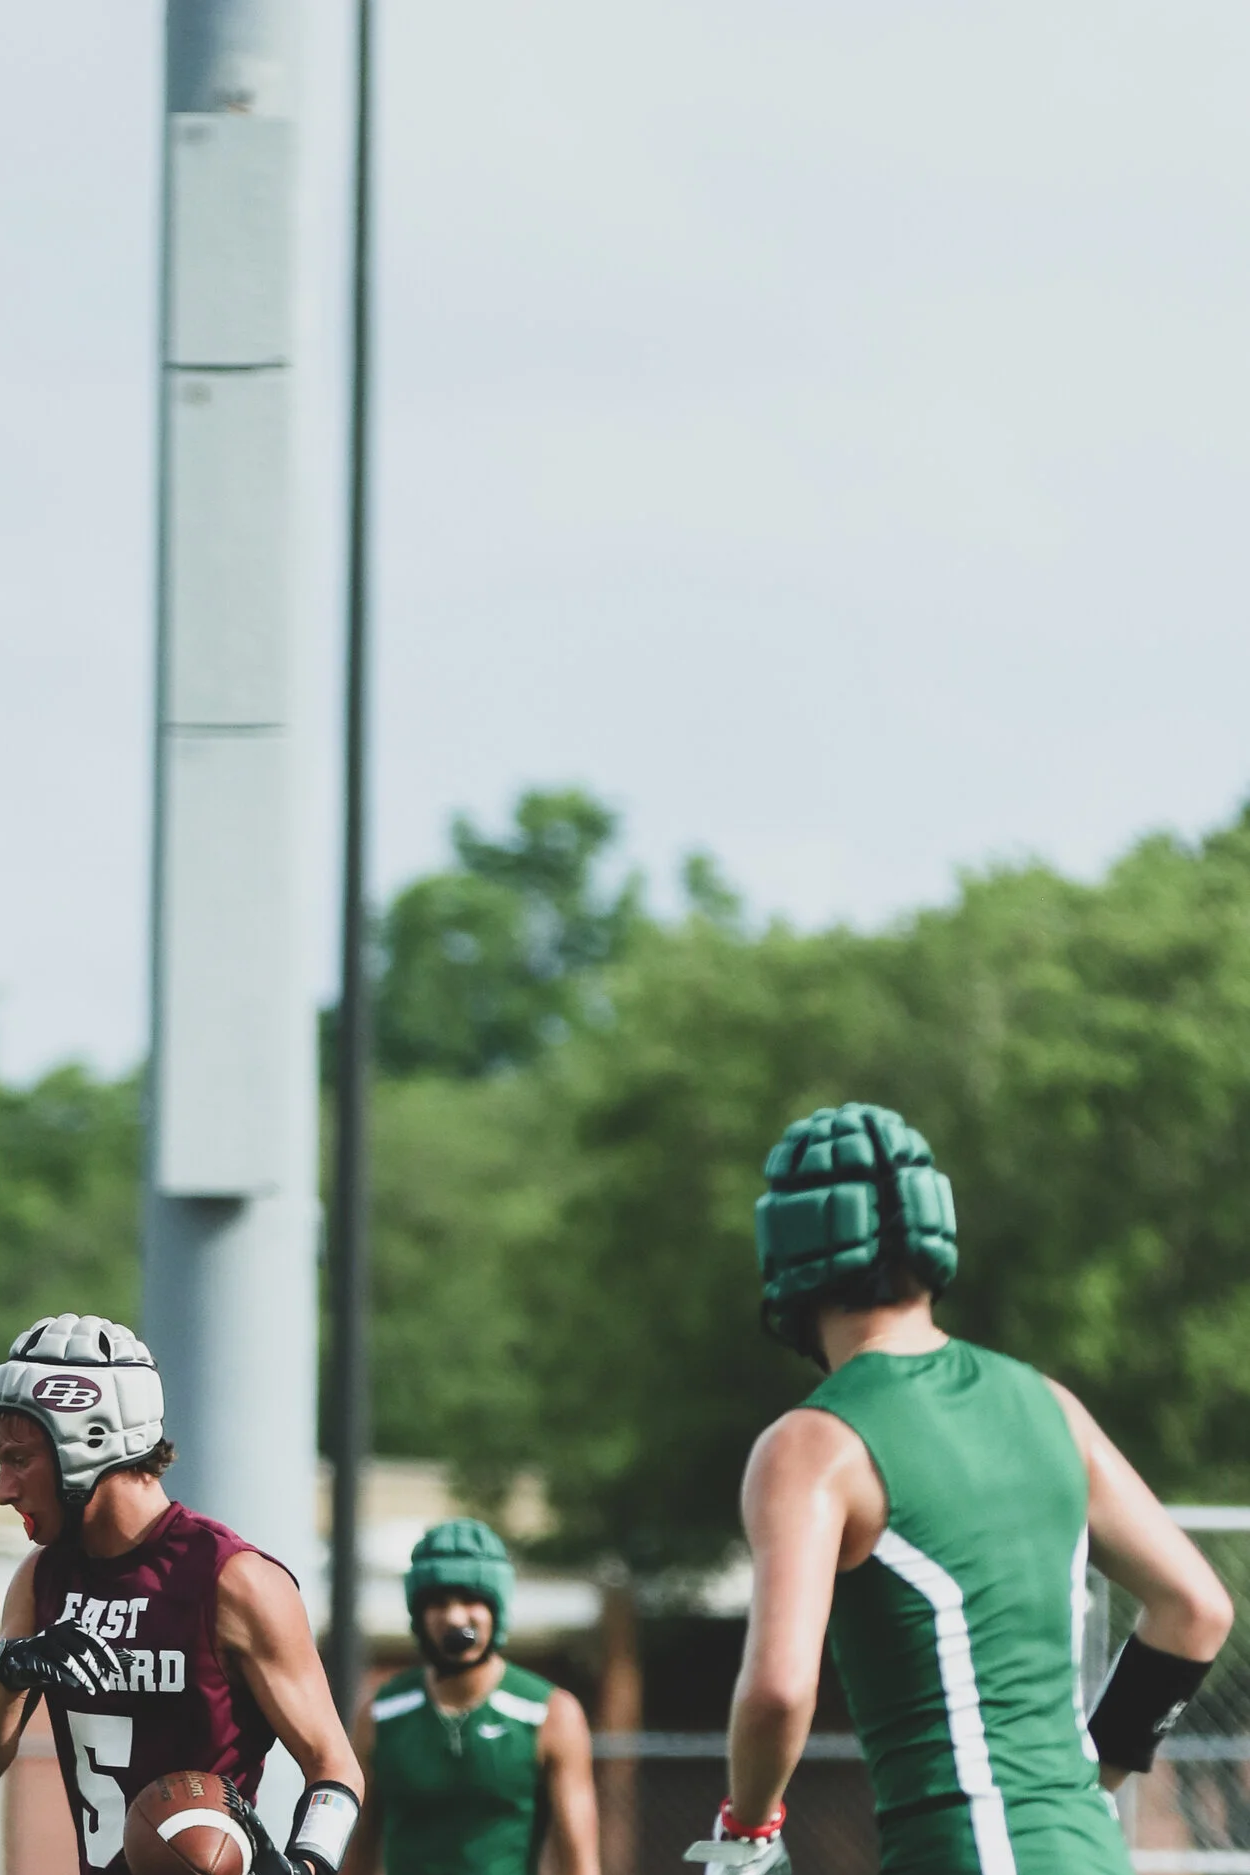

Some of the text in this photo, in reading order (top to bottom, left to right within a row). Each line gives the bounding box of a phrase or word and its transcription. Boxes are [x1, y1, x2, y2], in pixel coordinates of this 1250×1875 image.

[36, 1380, 99, 1408] EB
[54, 1592, 149, 1639] EAST
[66, 1709, 133, 1868] 5
